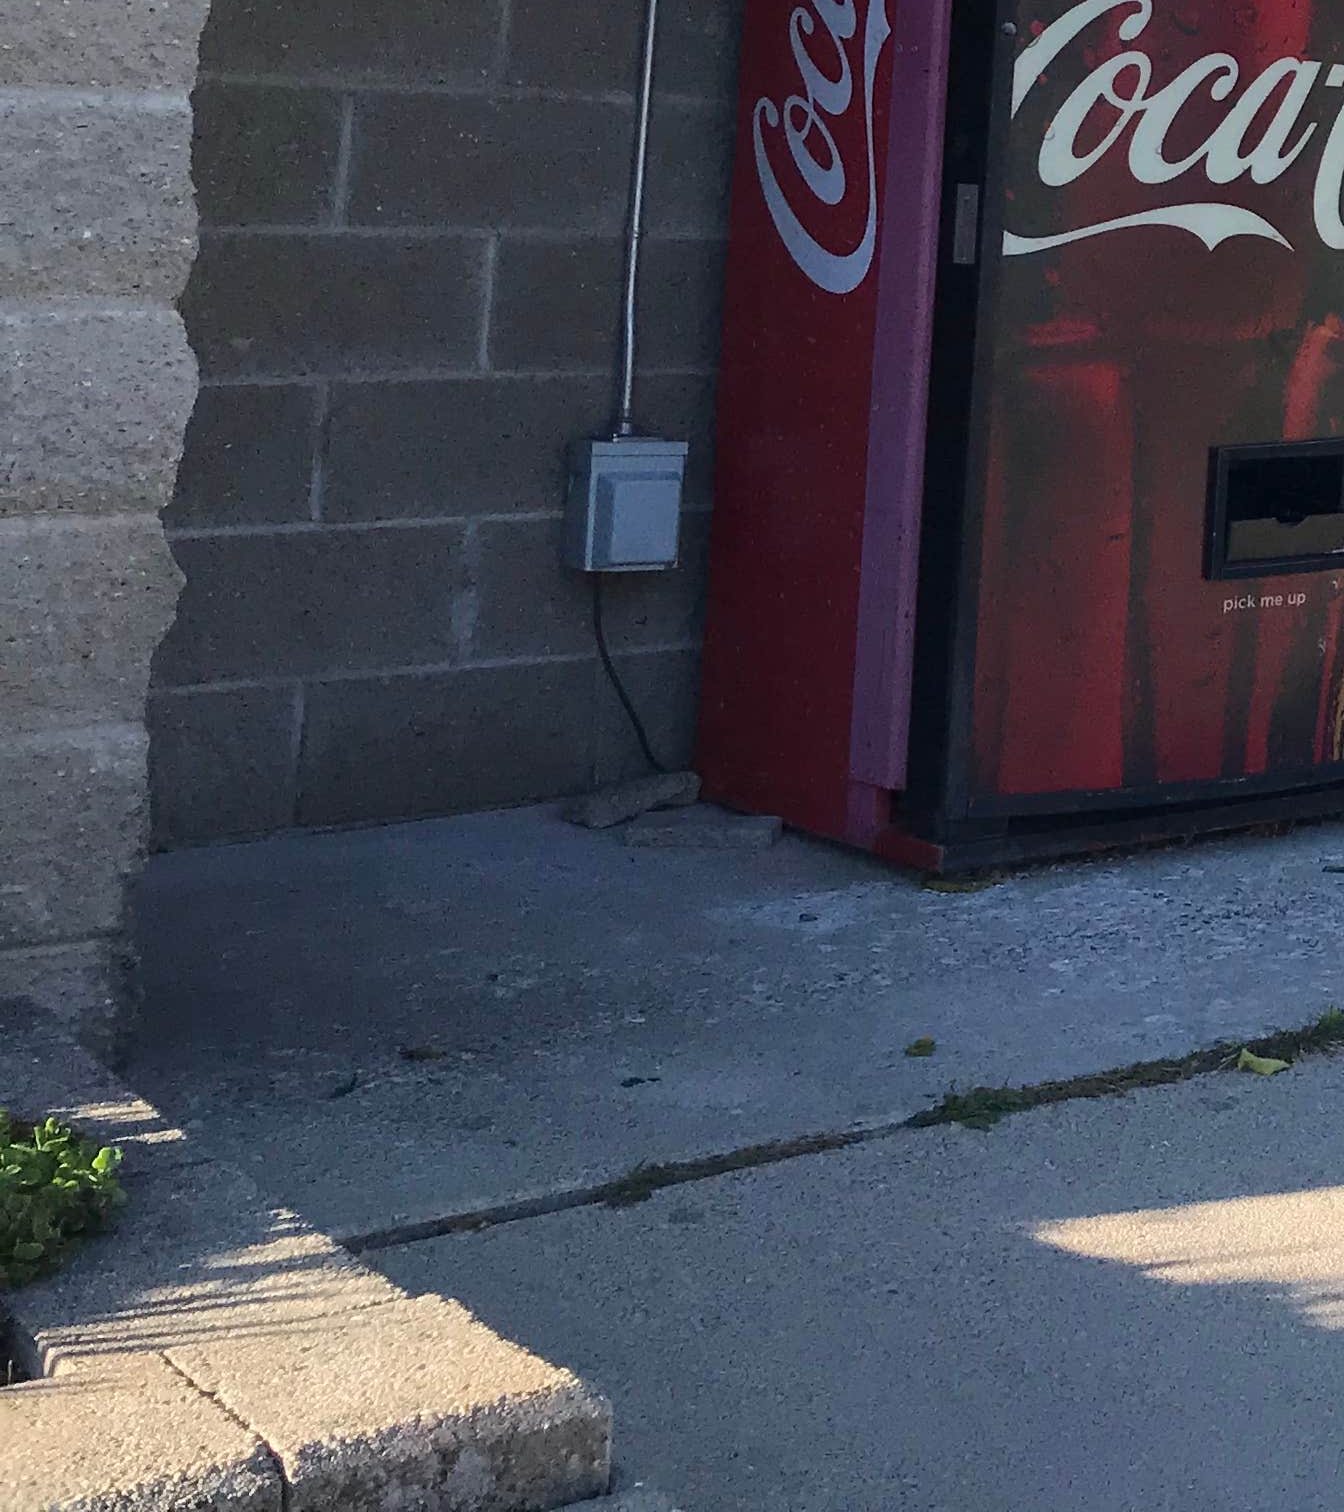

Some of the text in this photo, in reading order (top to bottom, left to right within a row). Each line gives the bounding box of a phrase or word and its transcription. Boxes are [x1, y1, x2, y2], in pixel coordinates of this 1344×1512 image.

[1222, 590, 1307, 614] pick me up
